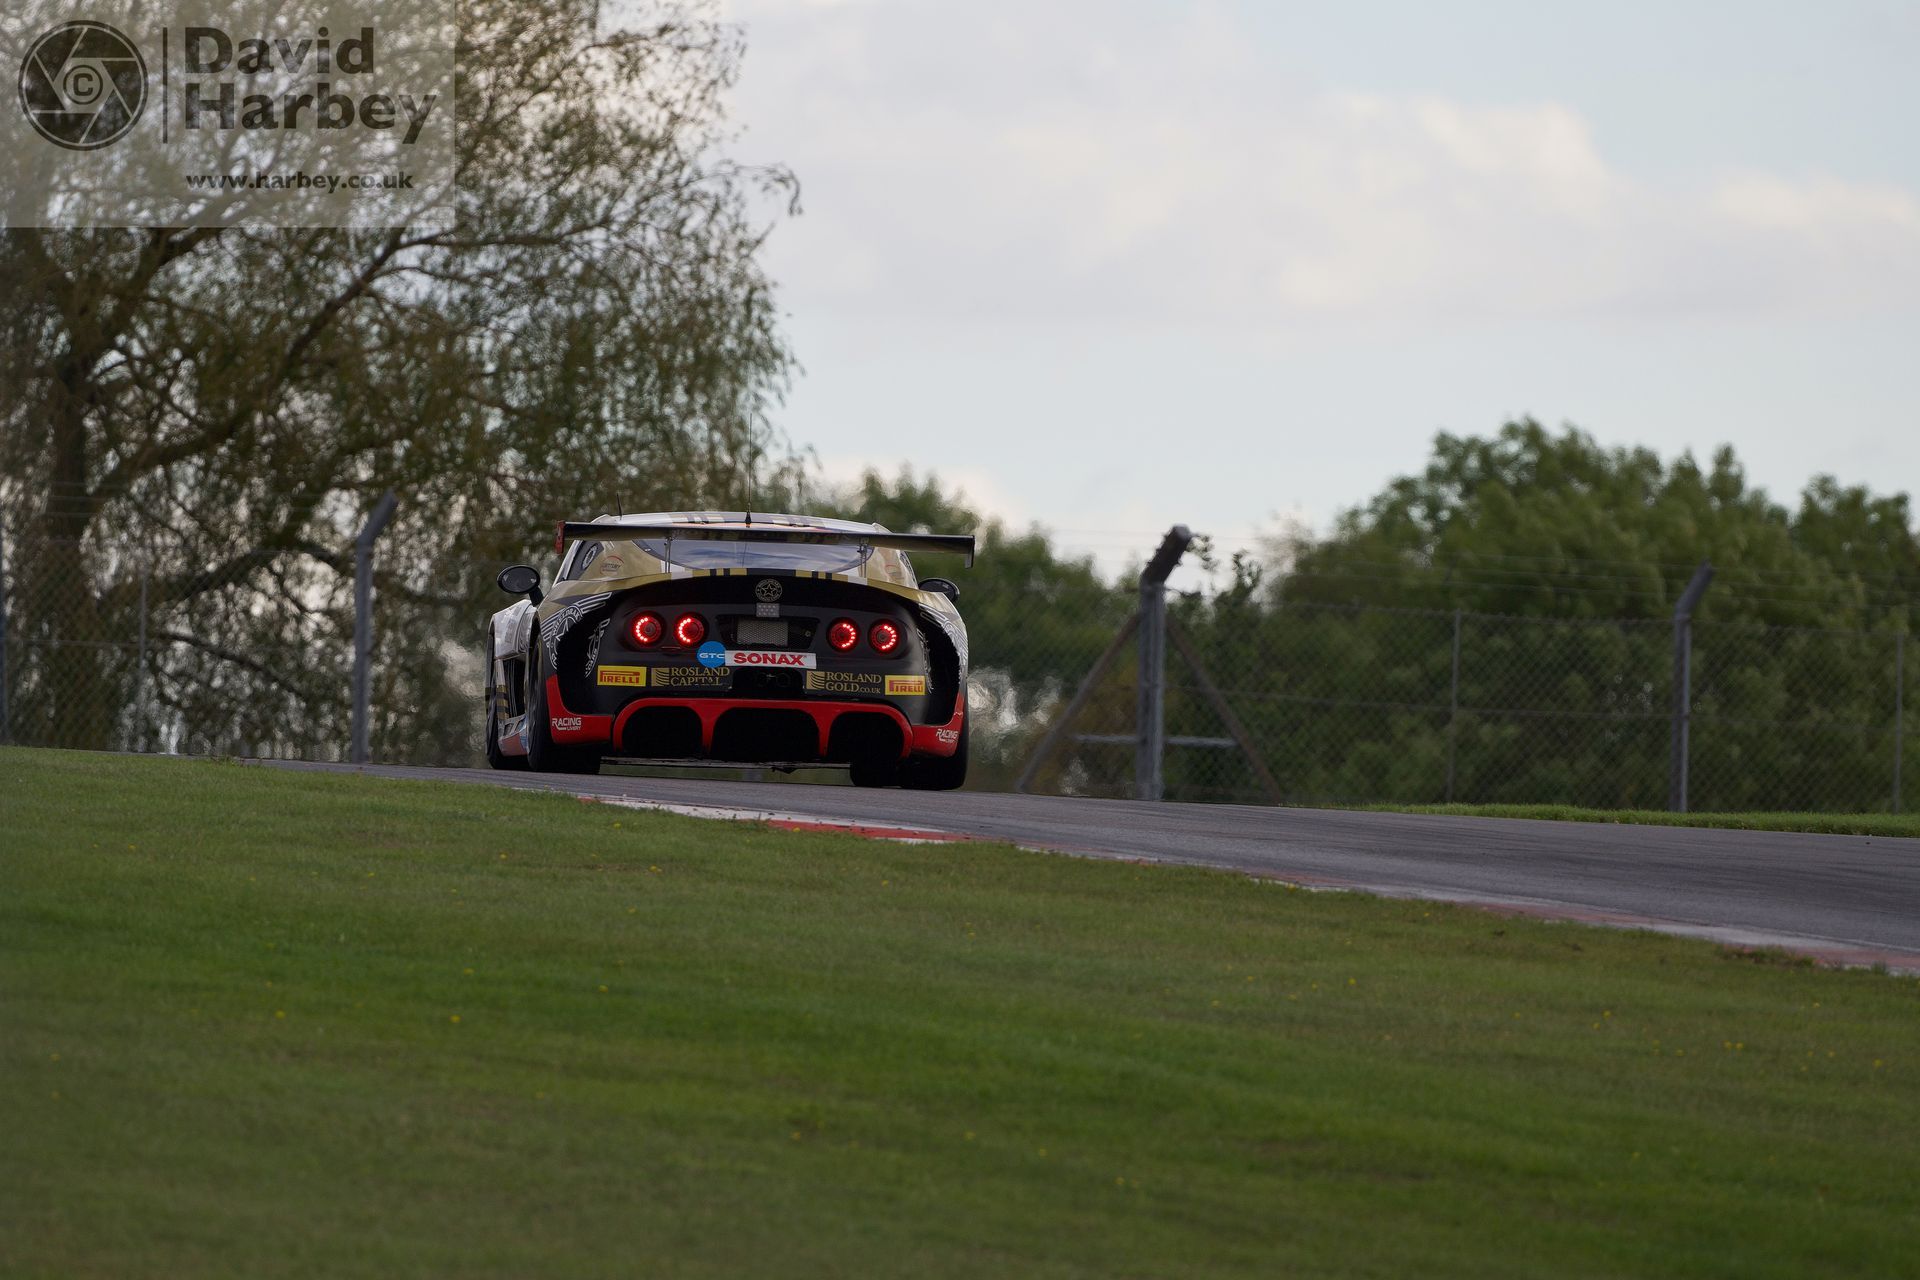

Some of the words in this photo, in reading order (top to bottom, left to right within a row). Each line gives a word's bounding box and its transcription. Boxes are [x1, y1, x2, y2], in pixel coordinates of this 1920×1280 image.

[734, 653, 805, 666] SONAX
[600, 671, 641, 684] PIRELLI
[671, 667, 730, 677] ROSLAND
[826, 671, 882, 684] ROSLAND
[889, 680, 923, 693] PIRELLI
[552, 718, 581, 729] RACING
[936, 729, 959, 740] RACING
